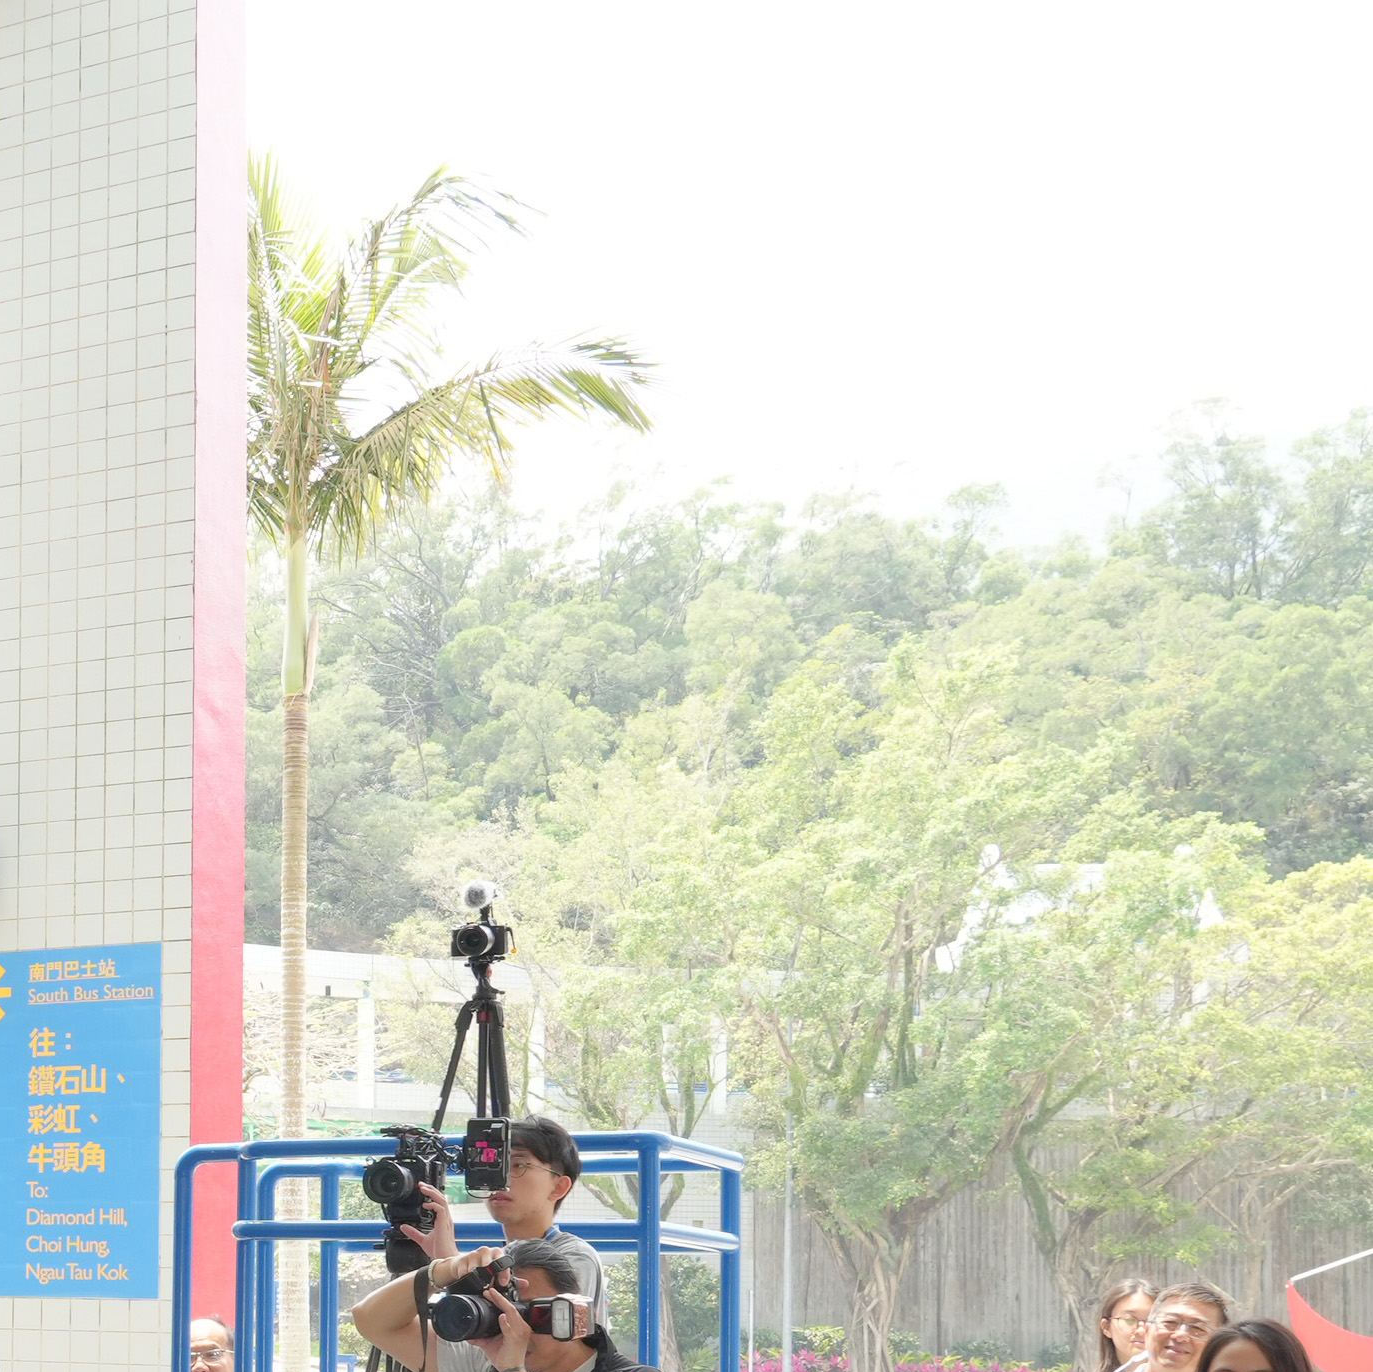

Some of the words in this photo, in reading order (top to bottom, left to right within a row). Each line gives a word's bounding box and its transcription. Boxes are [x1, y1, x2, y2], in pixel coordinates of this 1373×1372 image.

[28, 959, 116, 981] 南門巴士站
[28, 987, 68, 1002] South
[74, 986, 99, 1001] Bus
[103, 984, 154, 999] Station
[27, 1142, 105, 1173] 牛頭角
[26, 1181, 48, 1198] To:
[26, 1208, 95, 1226] Diamond
[99, 1208, 128, 1227] Hill,
[26, 1236, 62, 1253] Choi
[66, 1236, 110, 1257] Hung,
[26, 1263, 65, 1285] Ngau
[68, 1264, 92, 1281] Tau
[97, 1264, 129, 1281] Kok
